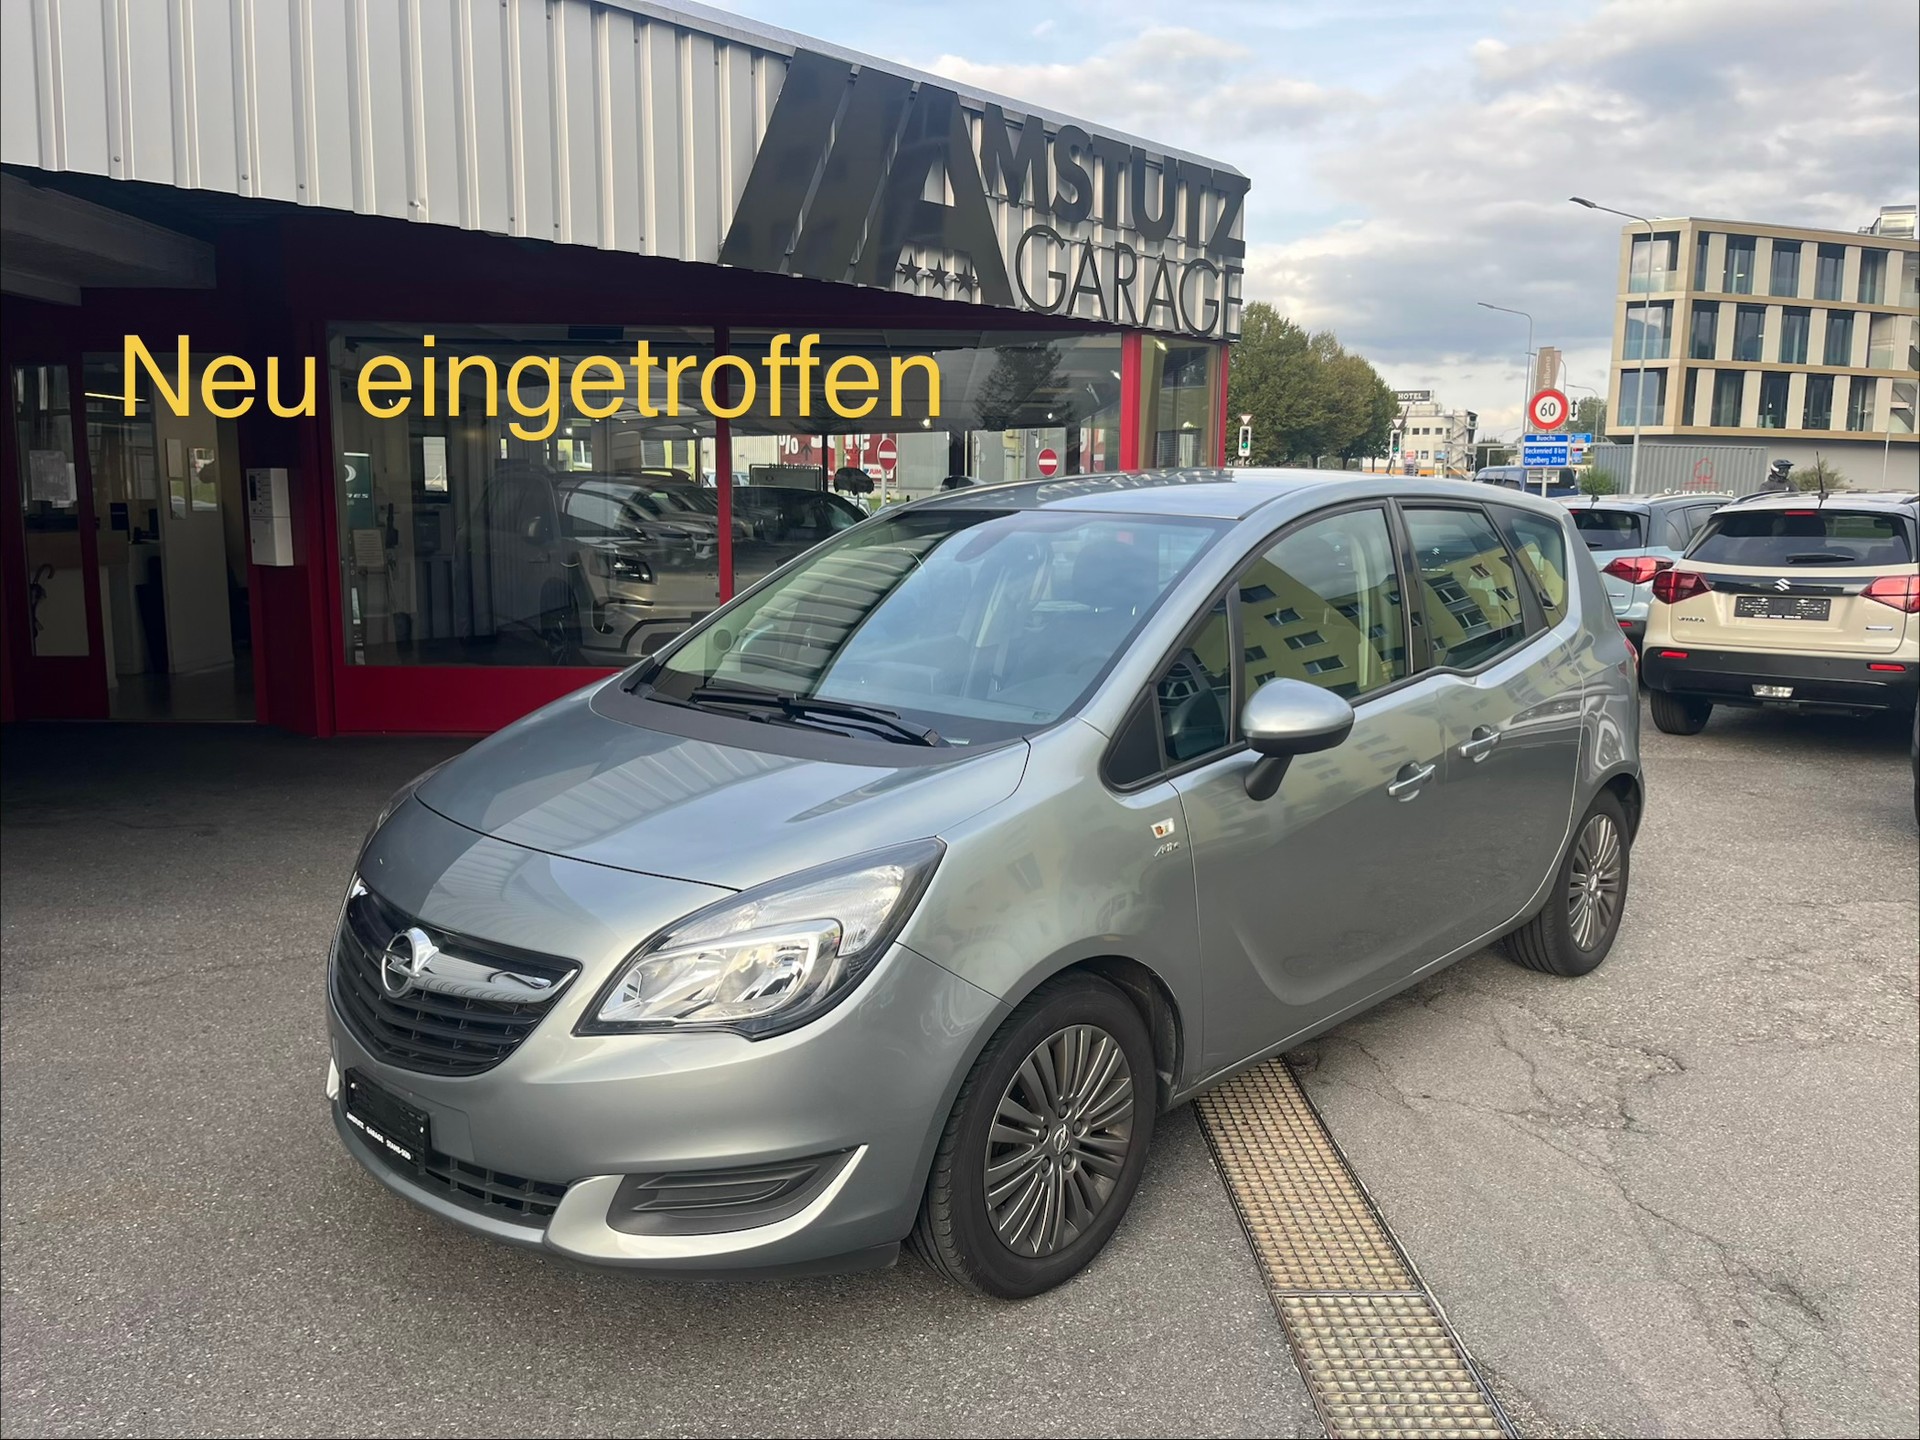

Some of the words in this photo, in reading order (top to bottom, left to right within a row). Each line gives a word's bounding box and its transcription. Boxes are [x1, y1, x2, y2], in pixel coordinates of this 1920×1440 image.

[855, 82, 1251, 307] AMSTUTZ
[1015, 224, 1244, 341] GARAGE
[1398, 392, 1423, 400] HOTEL
[1540, 402, 1556, 417] 60
[1525, 456, 1549, 464] Engelberg
